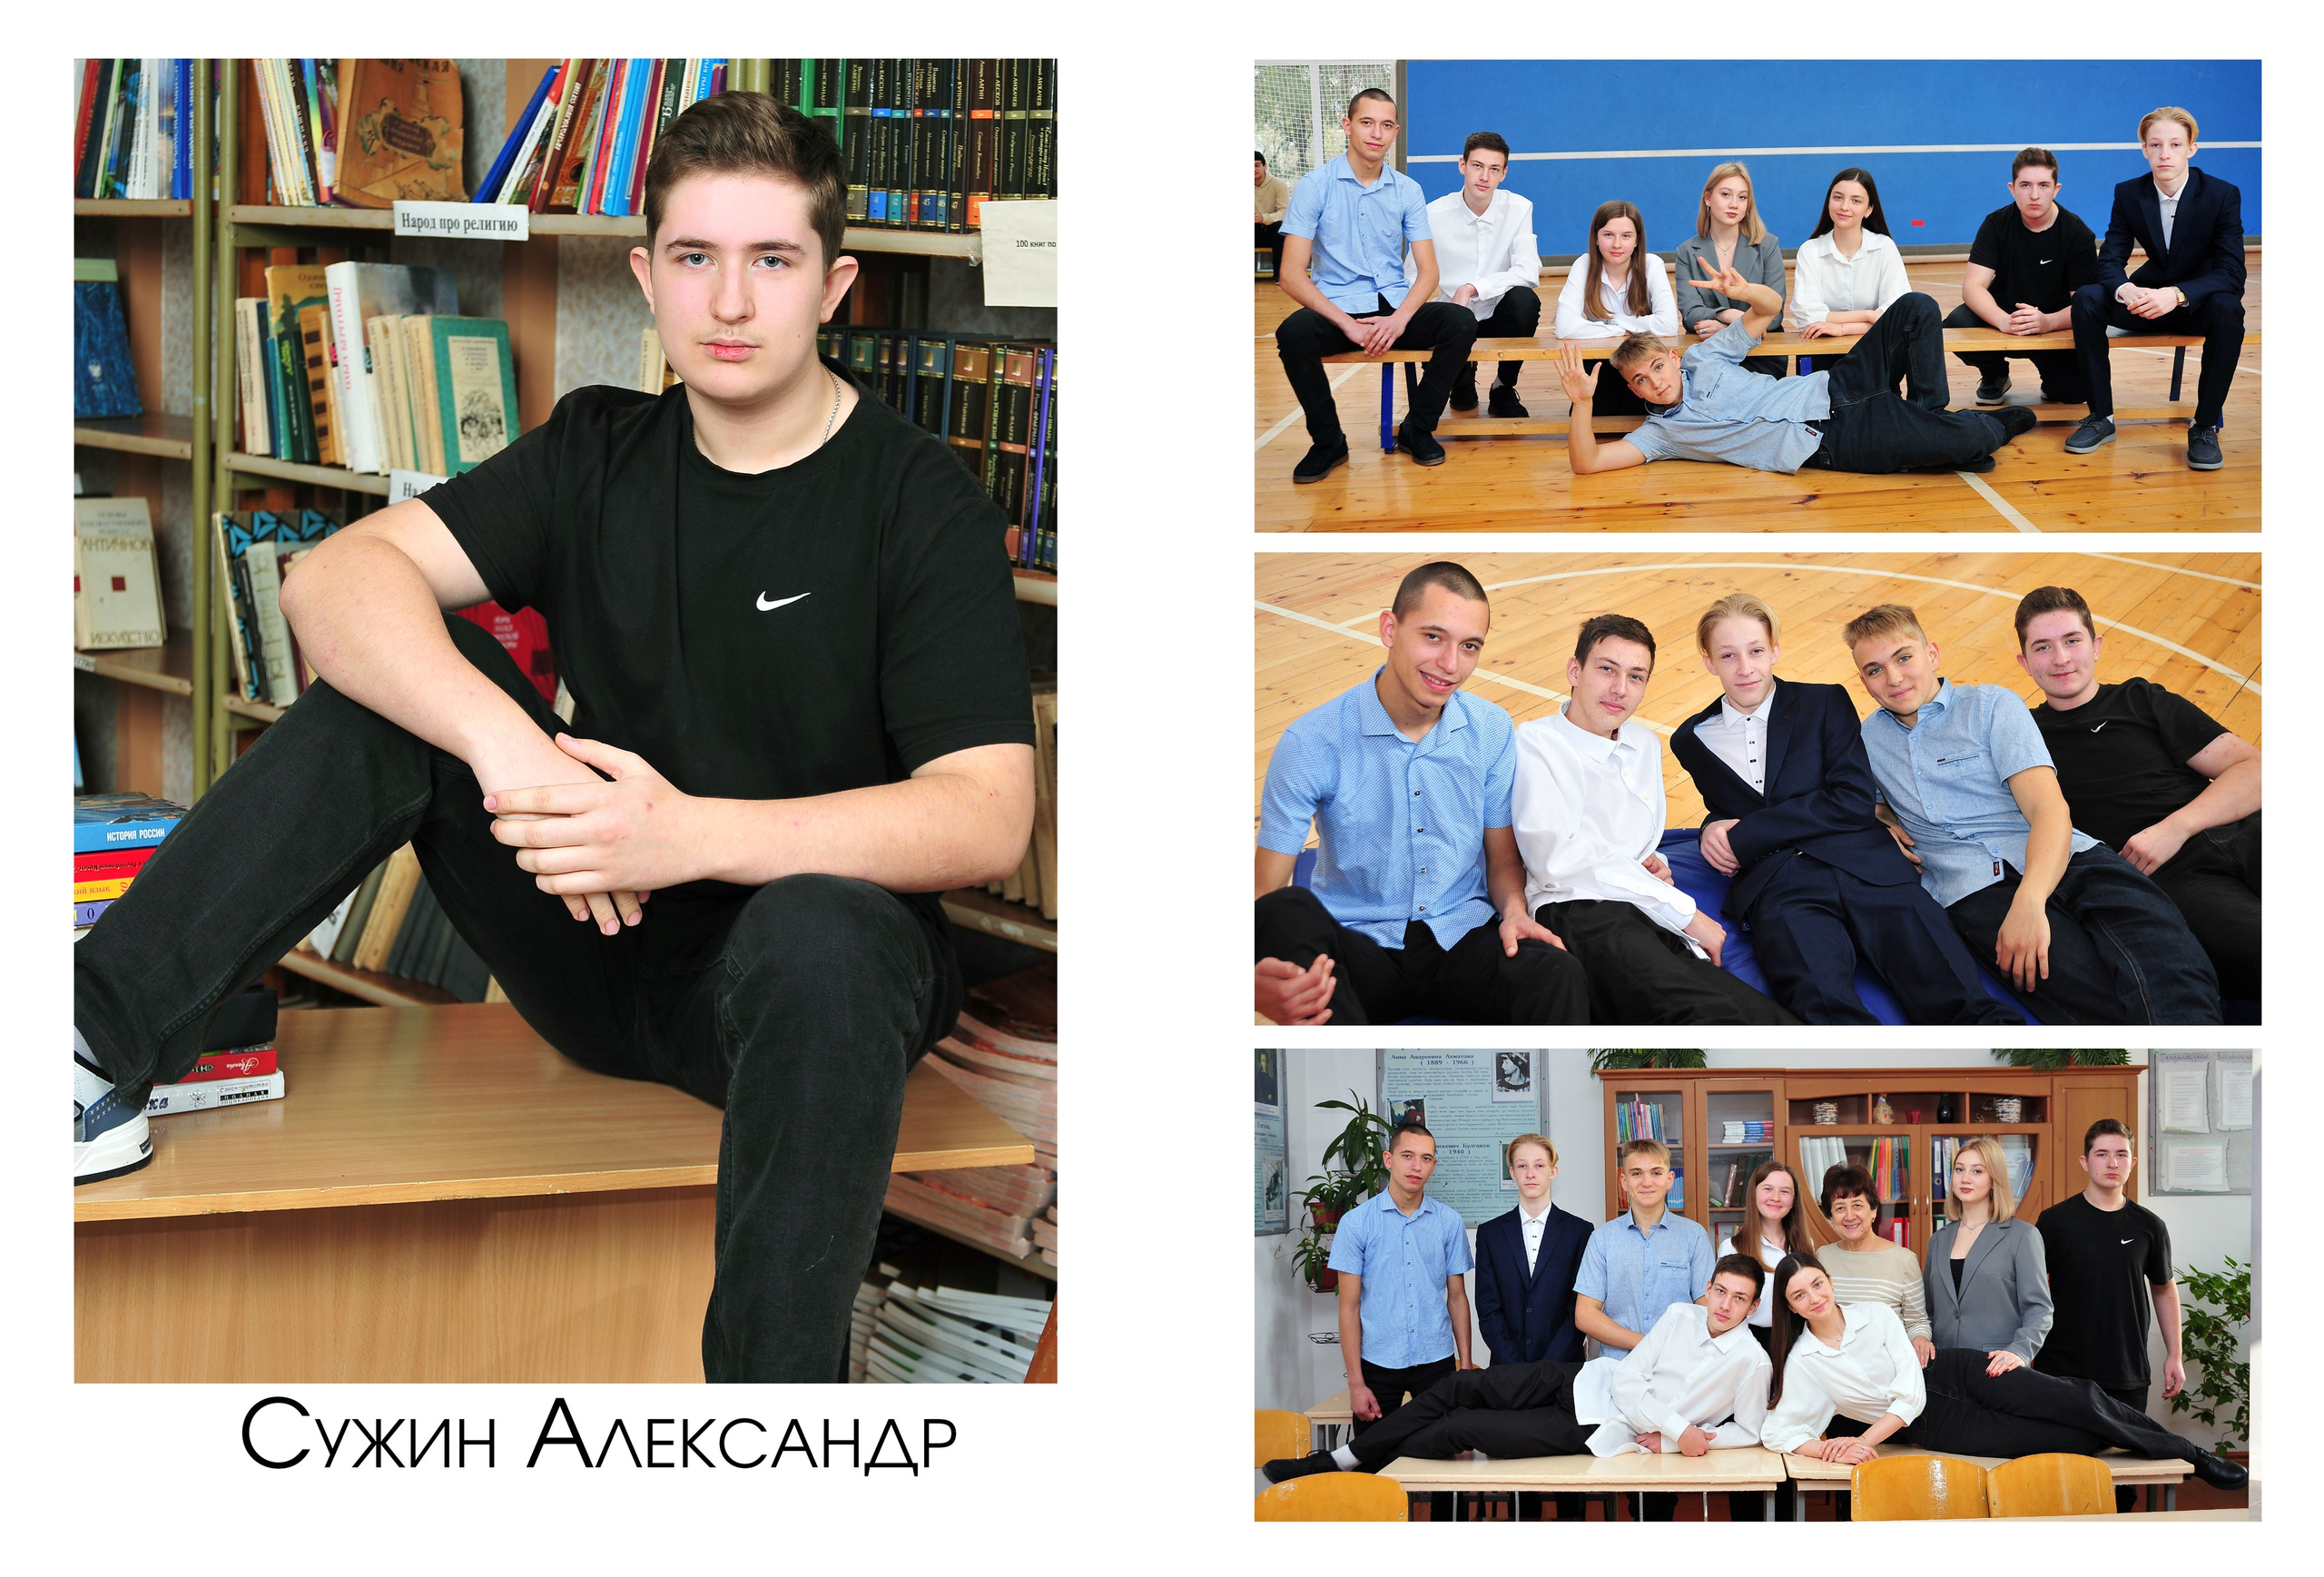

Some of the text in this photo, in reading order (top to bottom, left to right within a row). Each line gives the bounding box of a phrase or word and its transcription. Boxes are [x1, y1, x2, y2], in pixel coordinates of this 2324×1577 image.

[922, 198, 931, 206] 45
[402, 212, 518, 234] Народ про религию
[1016, 240, 1029, 248] 100
[991, 402, 1000, 439] УСПЕНСКИЙ
[1031, 410, 1039, 446] ФРАЕРМАН
[403, 482, 425, 497] На
[81, 537, 152, 552] АНТИЧНОЕ
[90, 631, 162, 646] ИСКУССТВО
[106, 828, 165, 842] ИСТОРИЯ РОССИИ
[74, 885, 111, 895] кий язык
[143, 1095, 169, 1110] ка
[221, 1095, 270, 1105] ЭНЦИКЛОПЕДИЯ
